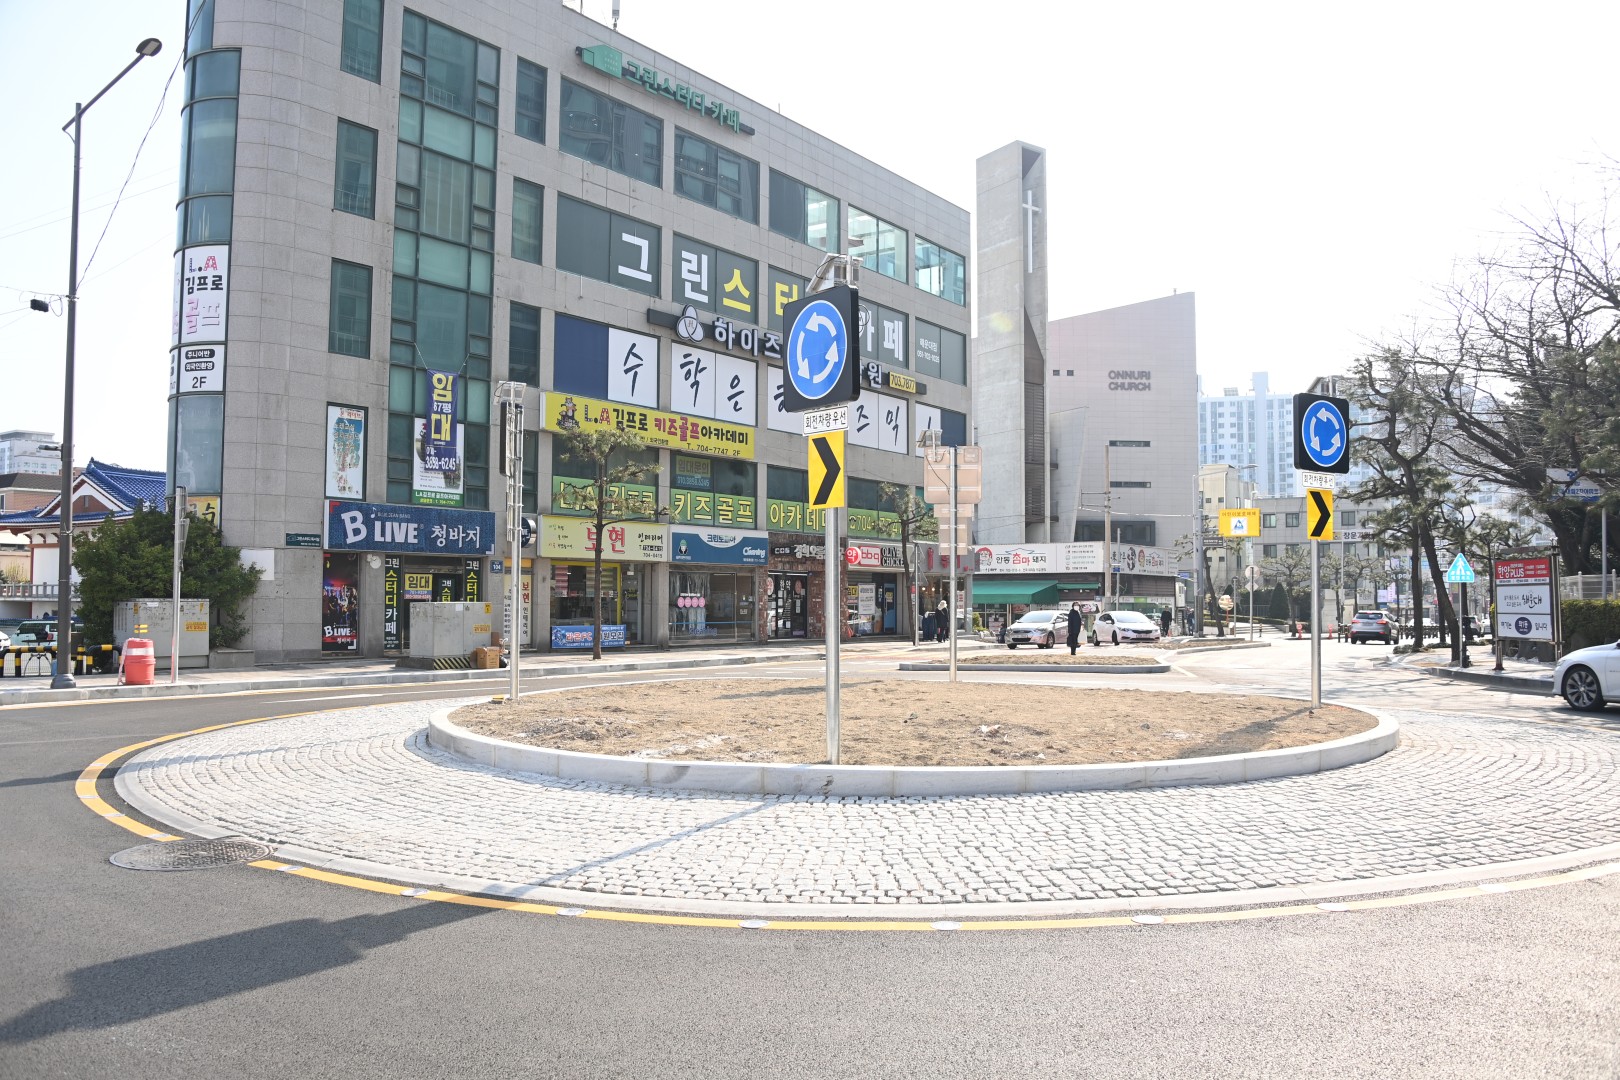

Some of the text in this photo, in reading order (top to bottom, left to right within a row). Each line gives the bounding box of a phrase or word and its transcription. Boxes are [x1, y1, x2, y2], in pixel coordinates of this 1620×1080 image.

[626, 60, 706, 117] 그린스터디
[711, 101, 740, 134] 카페
[185, 275, 223, 296] 김프로
[1108, 370, 1152, 380] ONNURI
[192, 376, 207, 389] 2F
[1108, 381, 1152, 391] CHURCH
[612, 408, 649, 432] 김프로
[341, 510, 418, 544] B LIVE
[430, 524, 481, 549] 청바지
[847, 549, 857, 561] 약
[385, 558, 400, 568] 그린
[465, 560, 480, 571] 그린
[407, 575, 430, 589] 임대
